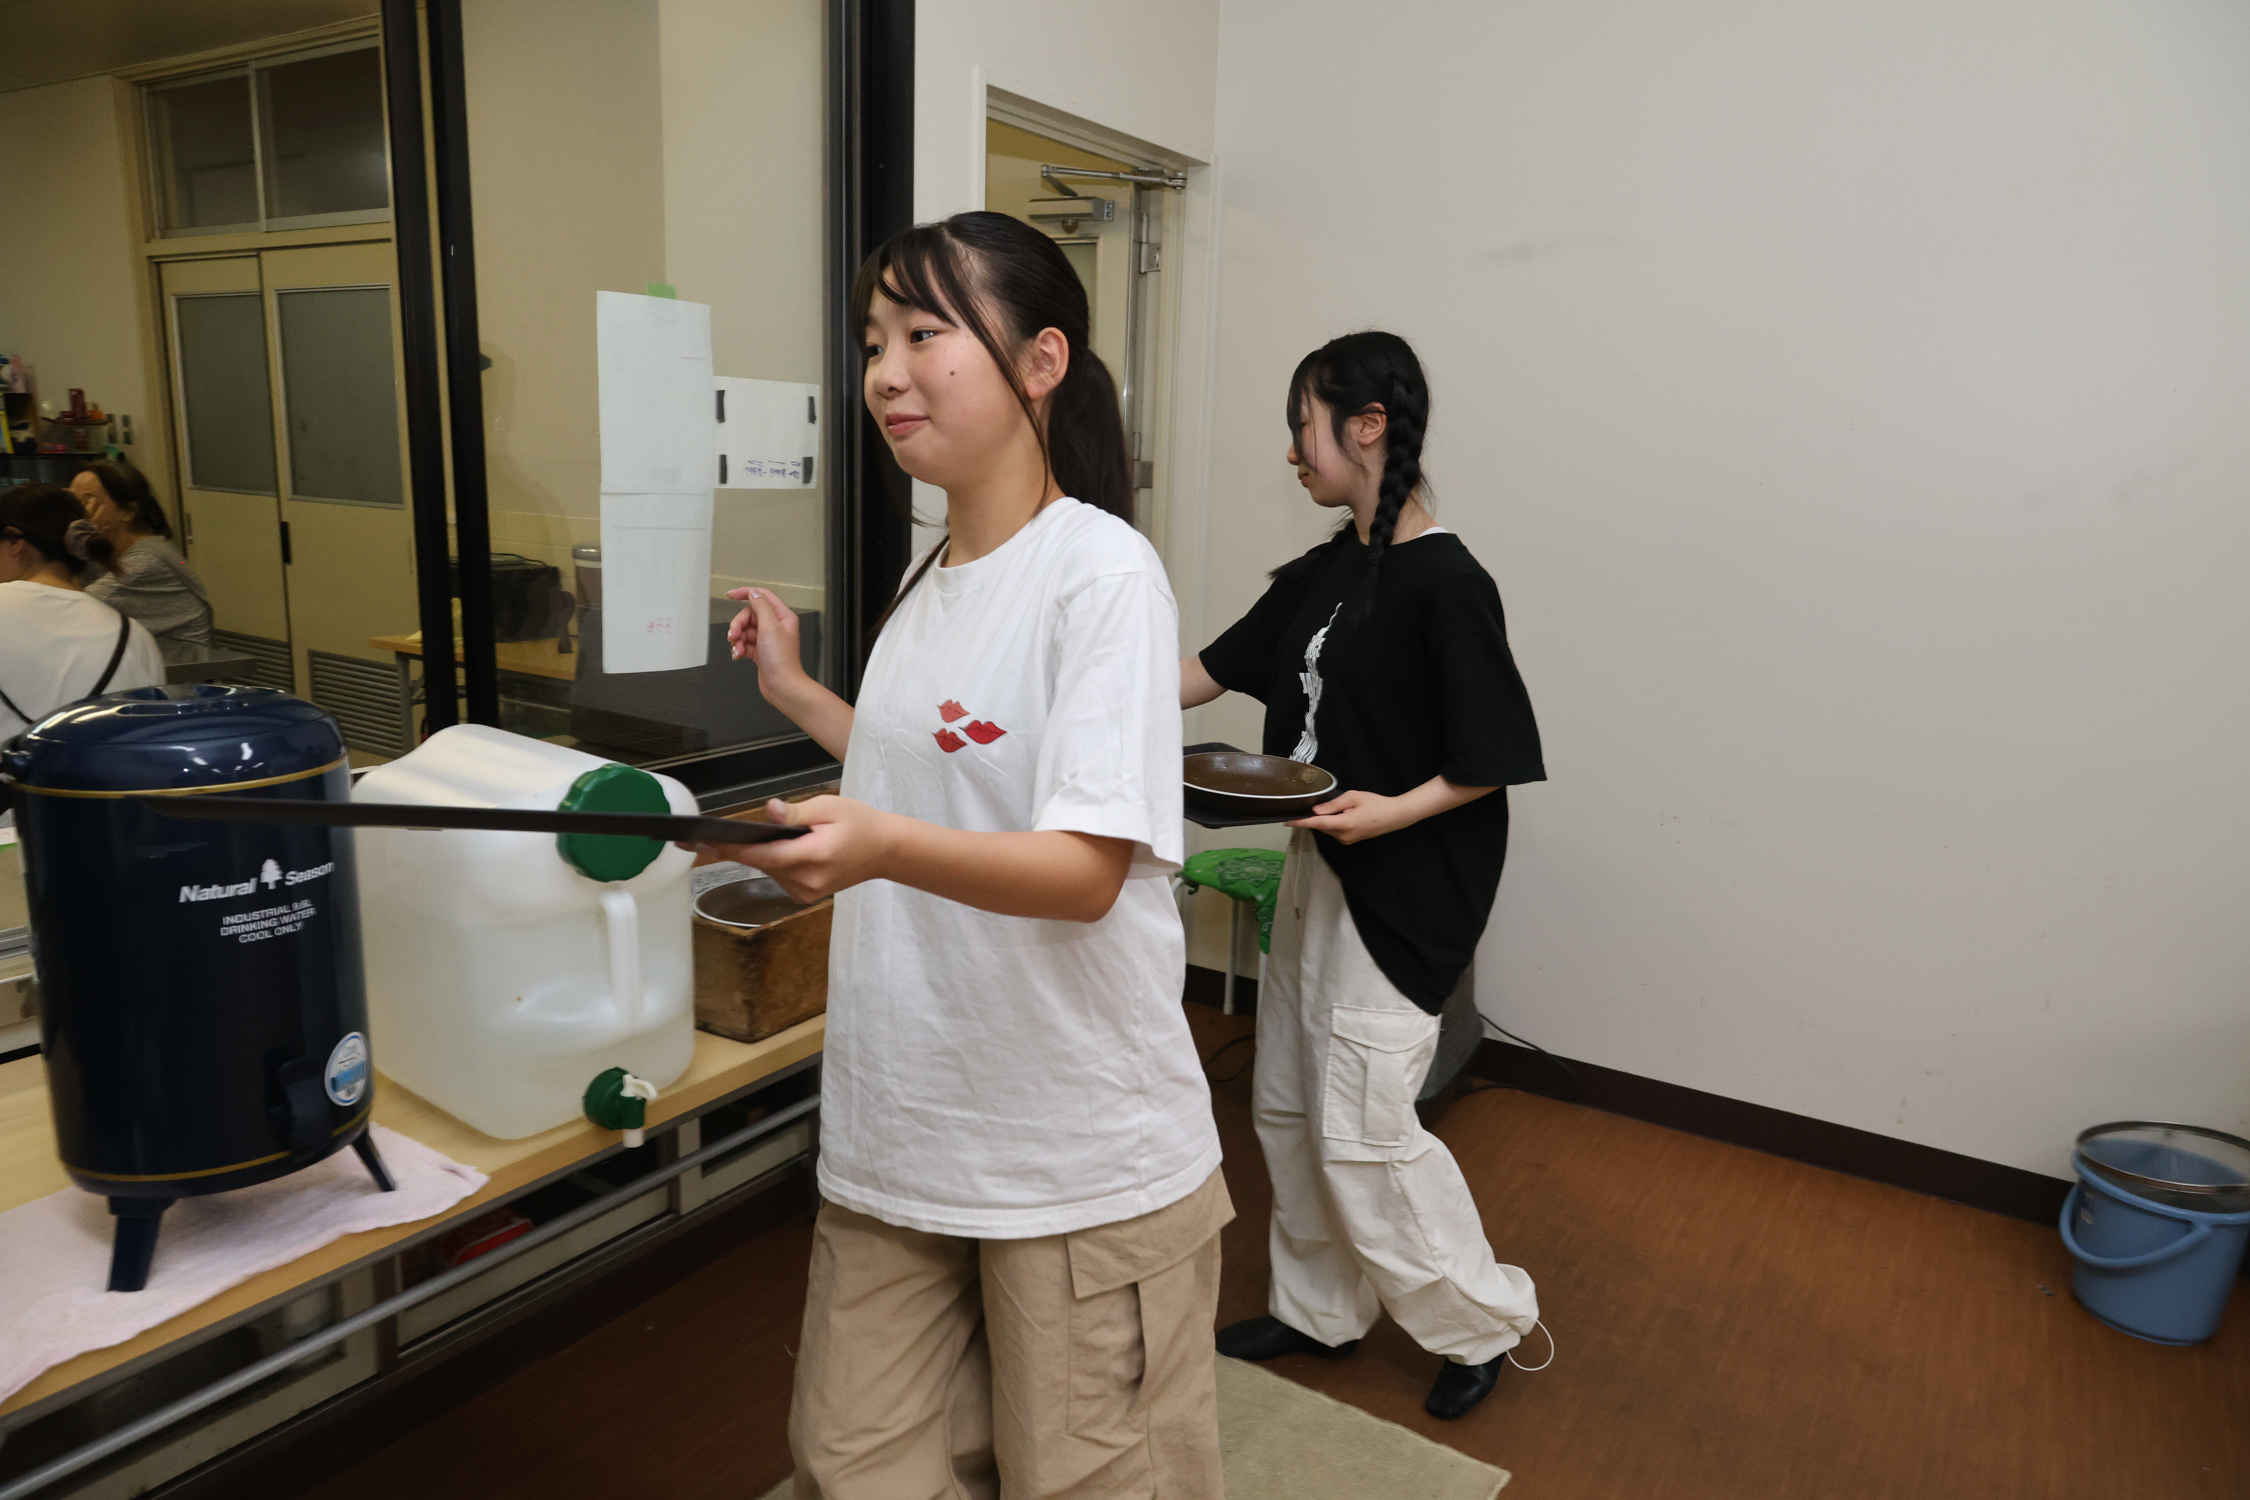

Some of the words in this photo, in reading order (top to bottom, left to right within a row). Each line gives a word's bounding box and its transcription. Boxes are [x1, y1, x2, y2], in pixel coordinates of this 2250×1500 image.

[179, 877, 258, 903] Natural
[220, 918, 278, 936] DRINKING
[279, 907, 317, 924] WATER
[222, 905, 290, 926] INDUSTRIAL
[238, 929, 274, 944] COOL
[274, 921, 304, 936] ONLY
